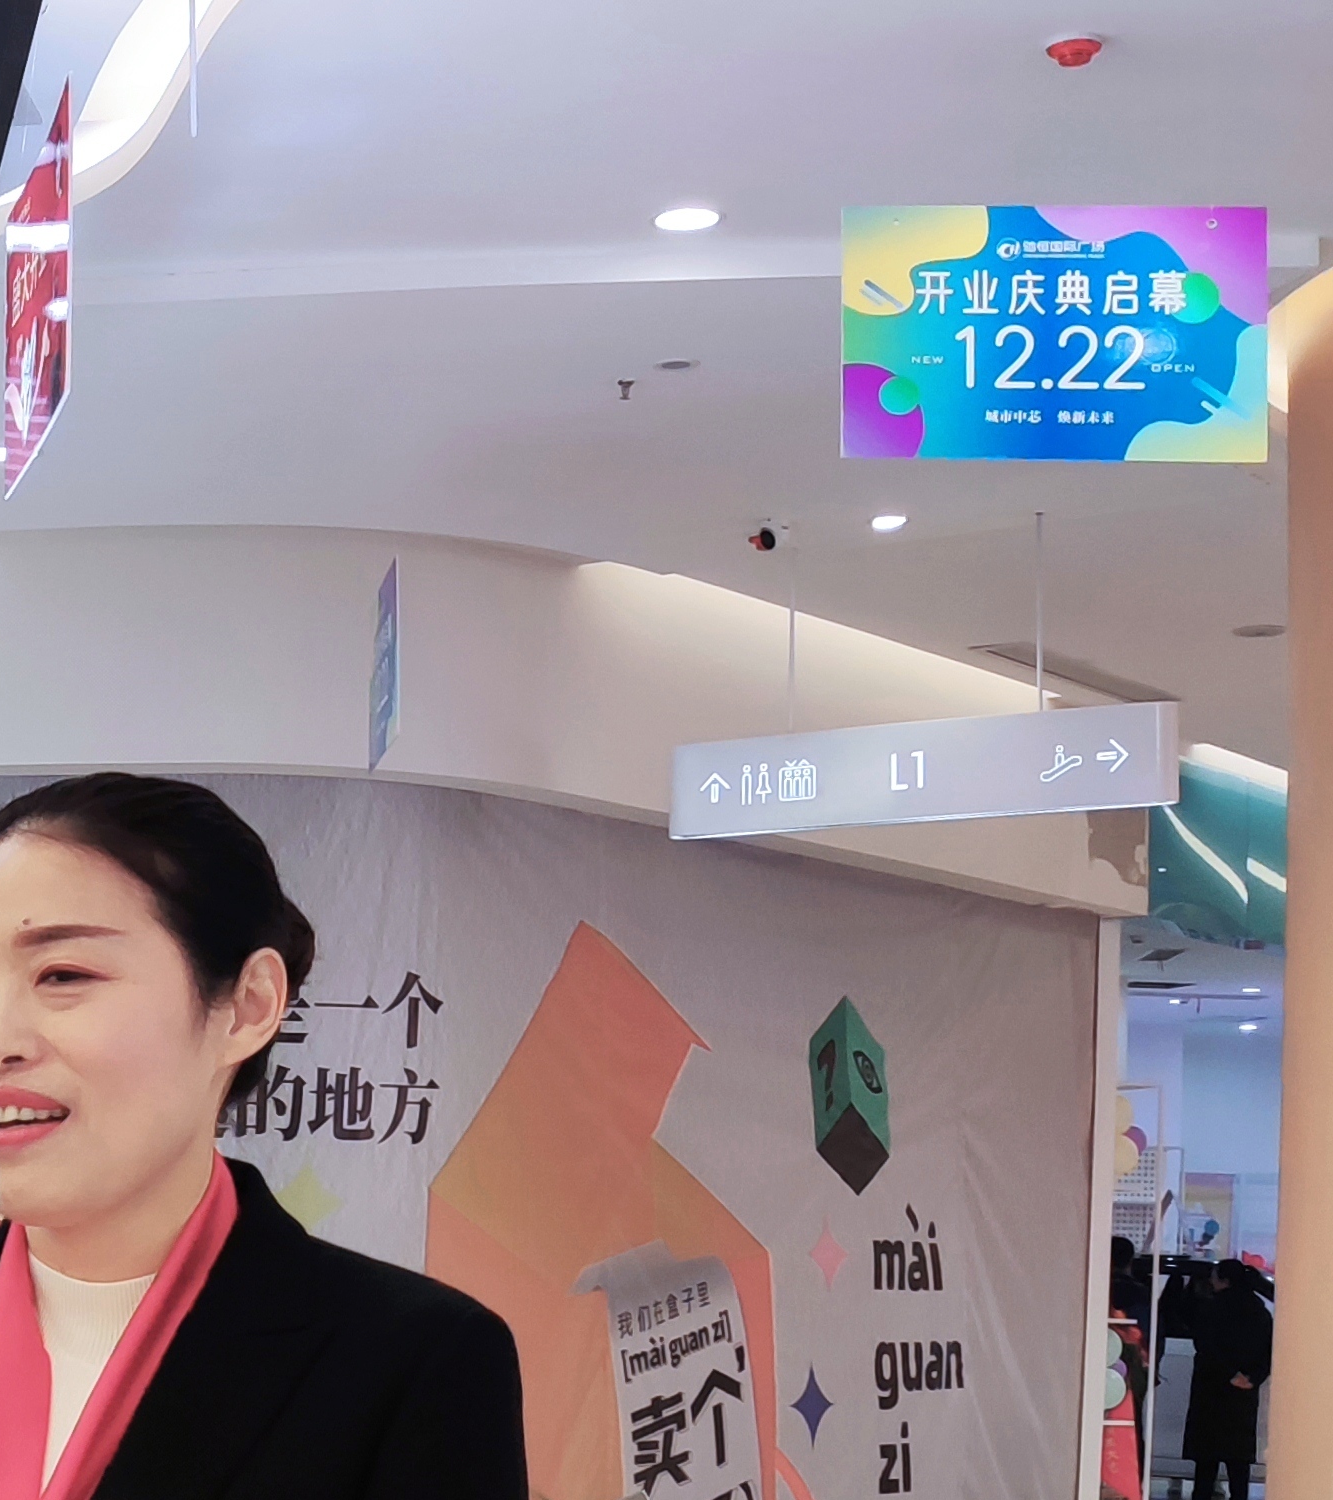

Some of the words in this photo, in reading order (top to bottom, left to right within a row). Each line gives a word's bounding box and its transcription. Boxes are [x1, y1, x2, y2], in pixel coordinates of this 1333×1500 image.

[915, 270, 1188, 317] 开业庆典启幕
[911, 355, 944, 365] NEW
[954, 325, 1146, 391] 12.22
[1151, 363, 1195, 374] OPEN
[891, 750, 926, 792] L1
[214, 1064, 440, 1145] 的地方
[872, 1203, 944, 1292] mài
[668, 1326, 711, 1369] guan
[874, 1336, 965, 1412] guan
[878, 1421, 912, 1495] zi
